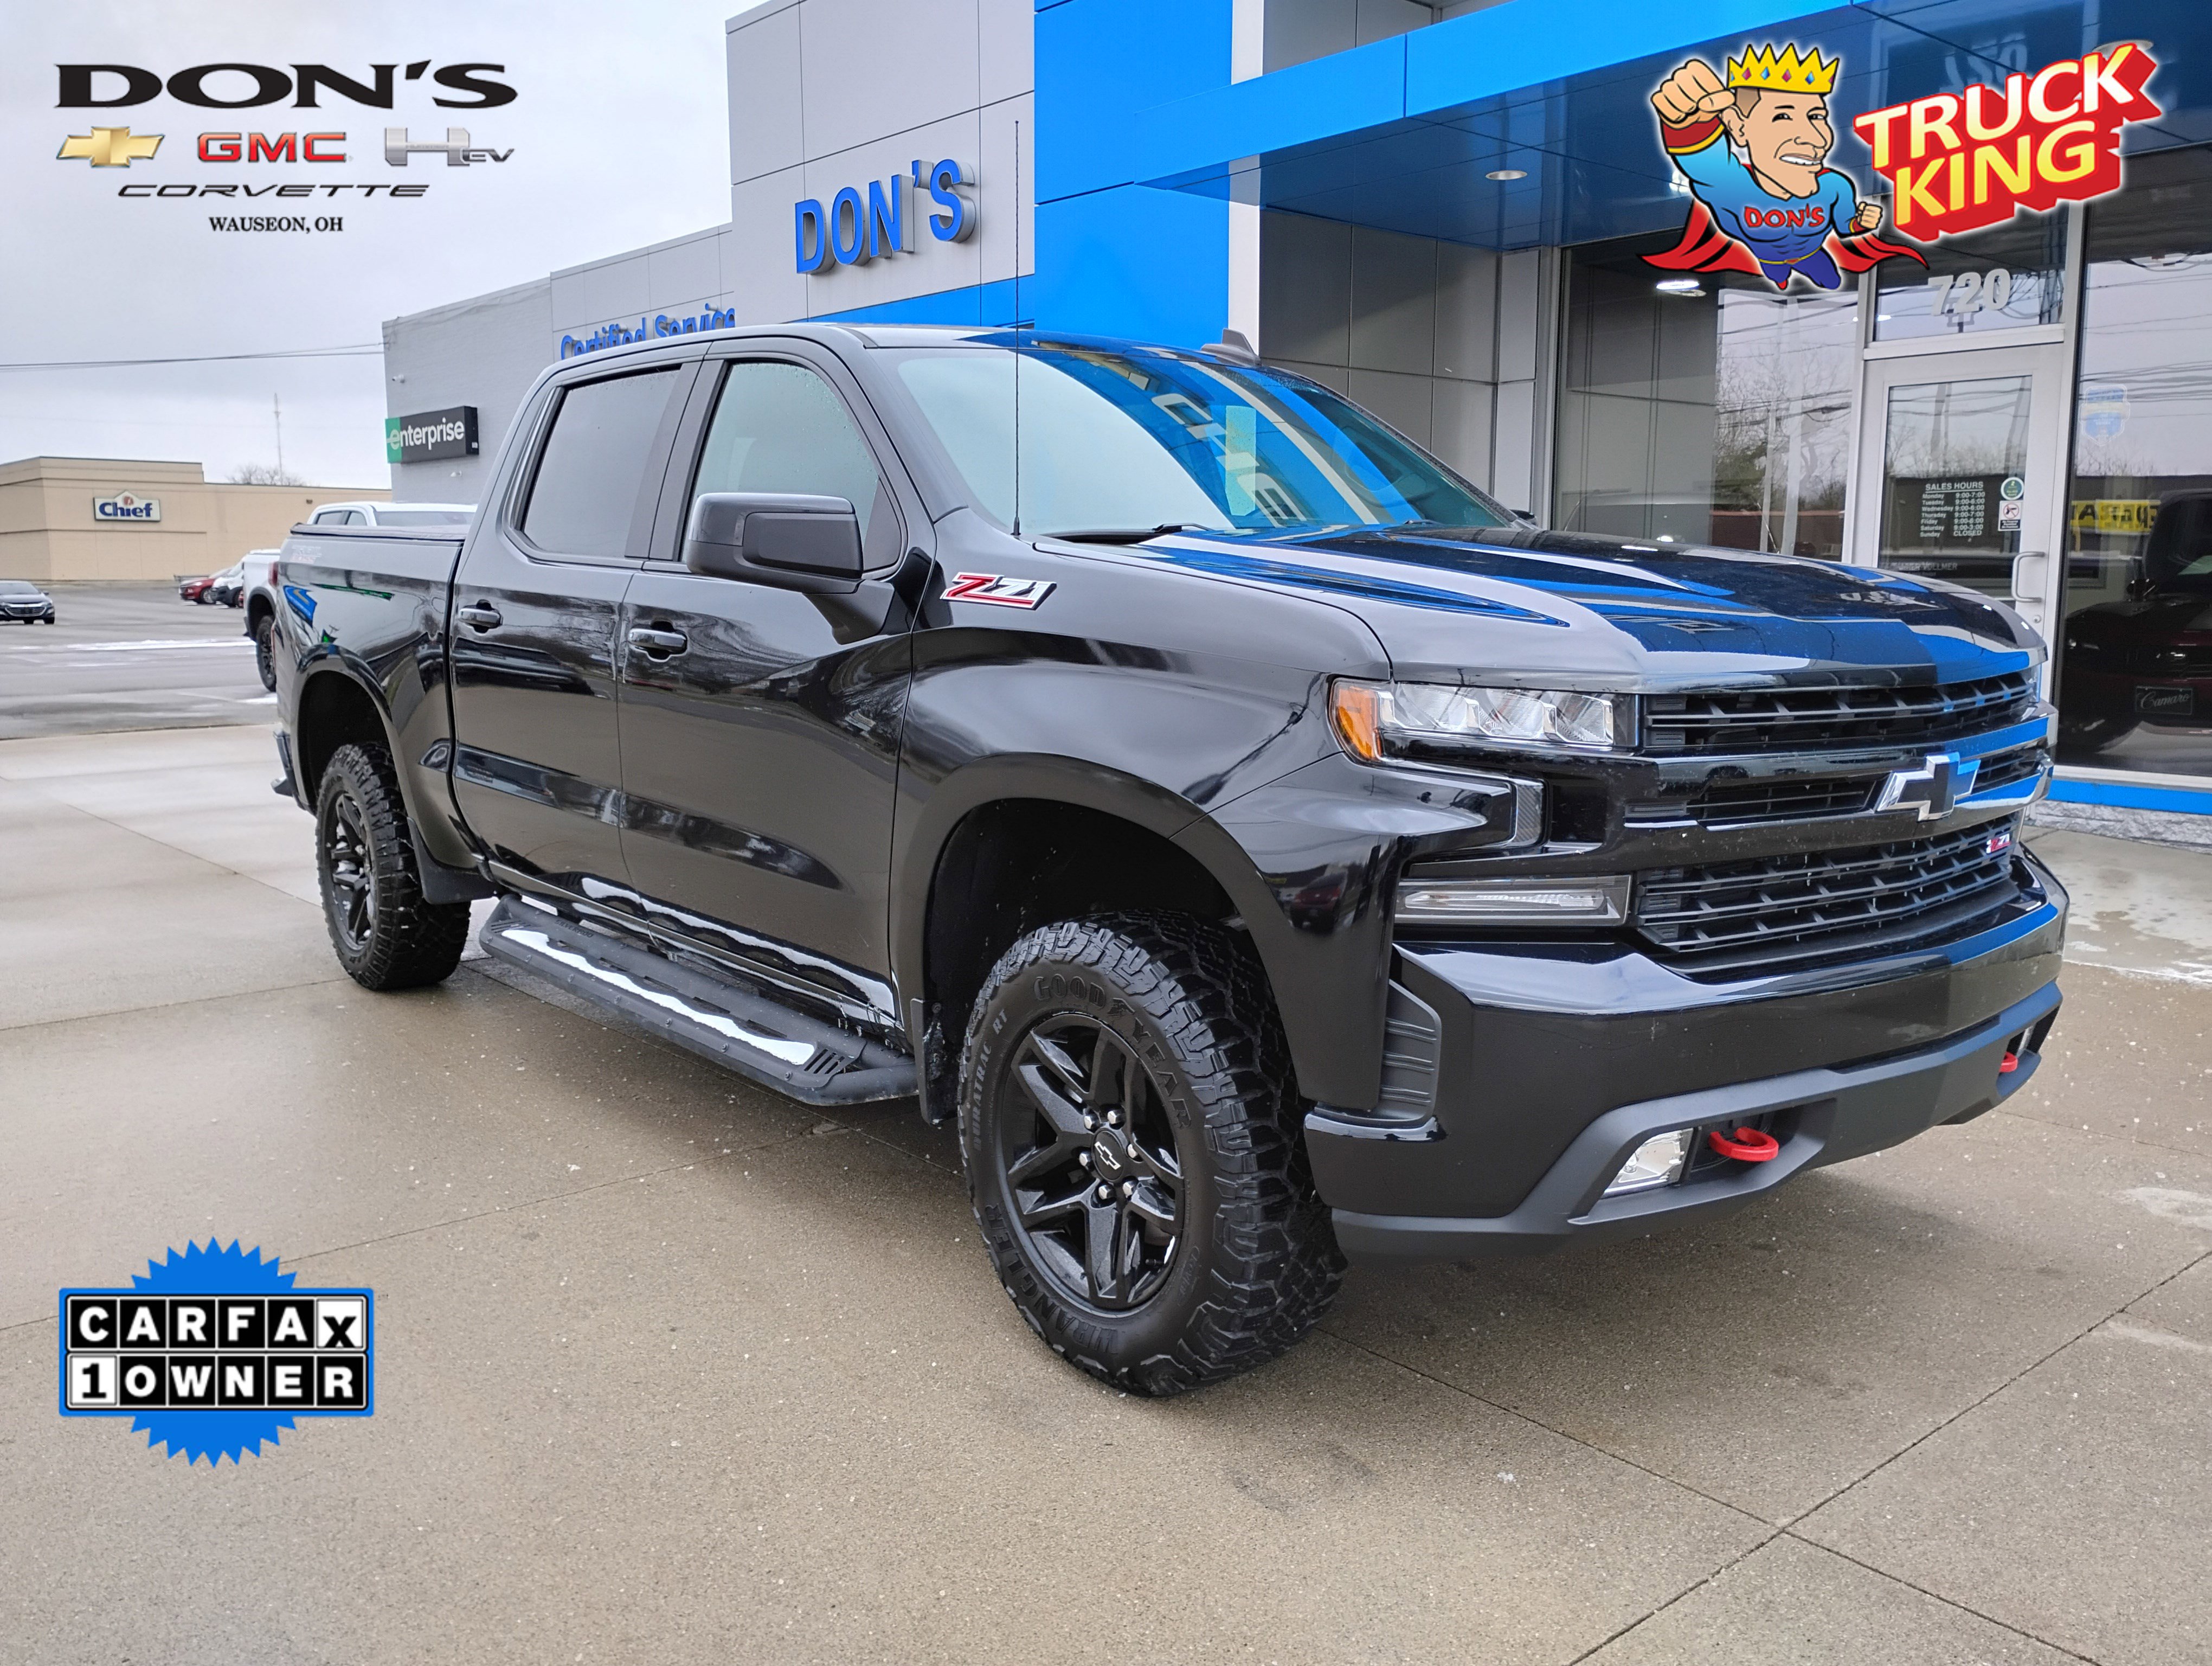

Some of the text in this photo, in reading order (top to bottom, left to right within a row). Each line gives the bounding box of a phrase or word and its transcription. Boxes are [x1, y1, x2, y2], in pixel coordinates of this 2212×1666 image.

[795, 159, 975, 275] DON'S
[1928, 268, 2011, 317] 720
[389, 417, 465, 451] enterprise
[1925, 483, 1952, 491] SALES
[99, 502, 153, 517] Chief
[940, 572, 1057, 611] Z71
[1986, 833, 2012, 854] Z71
